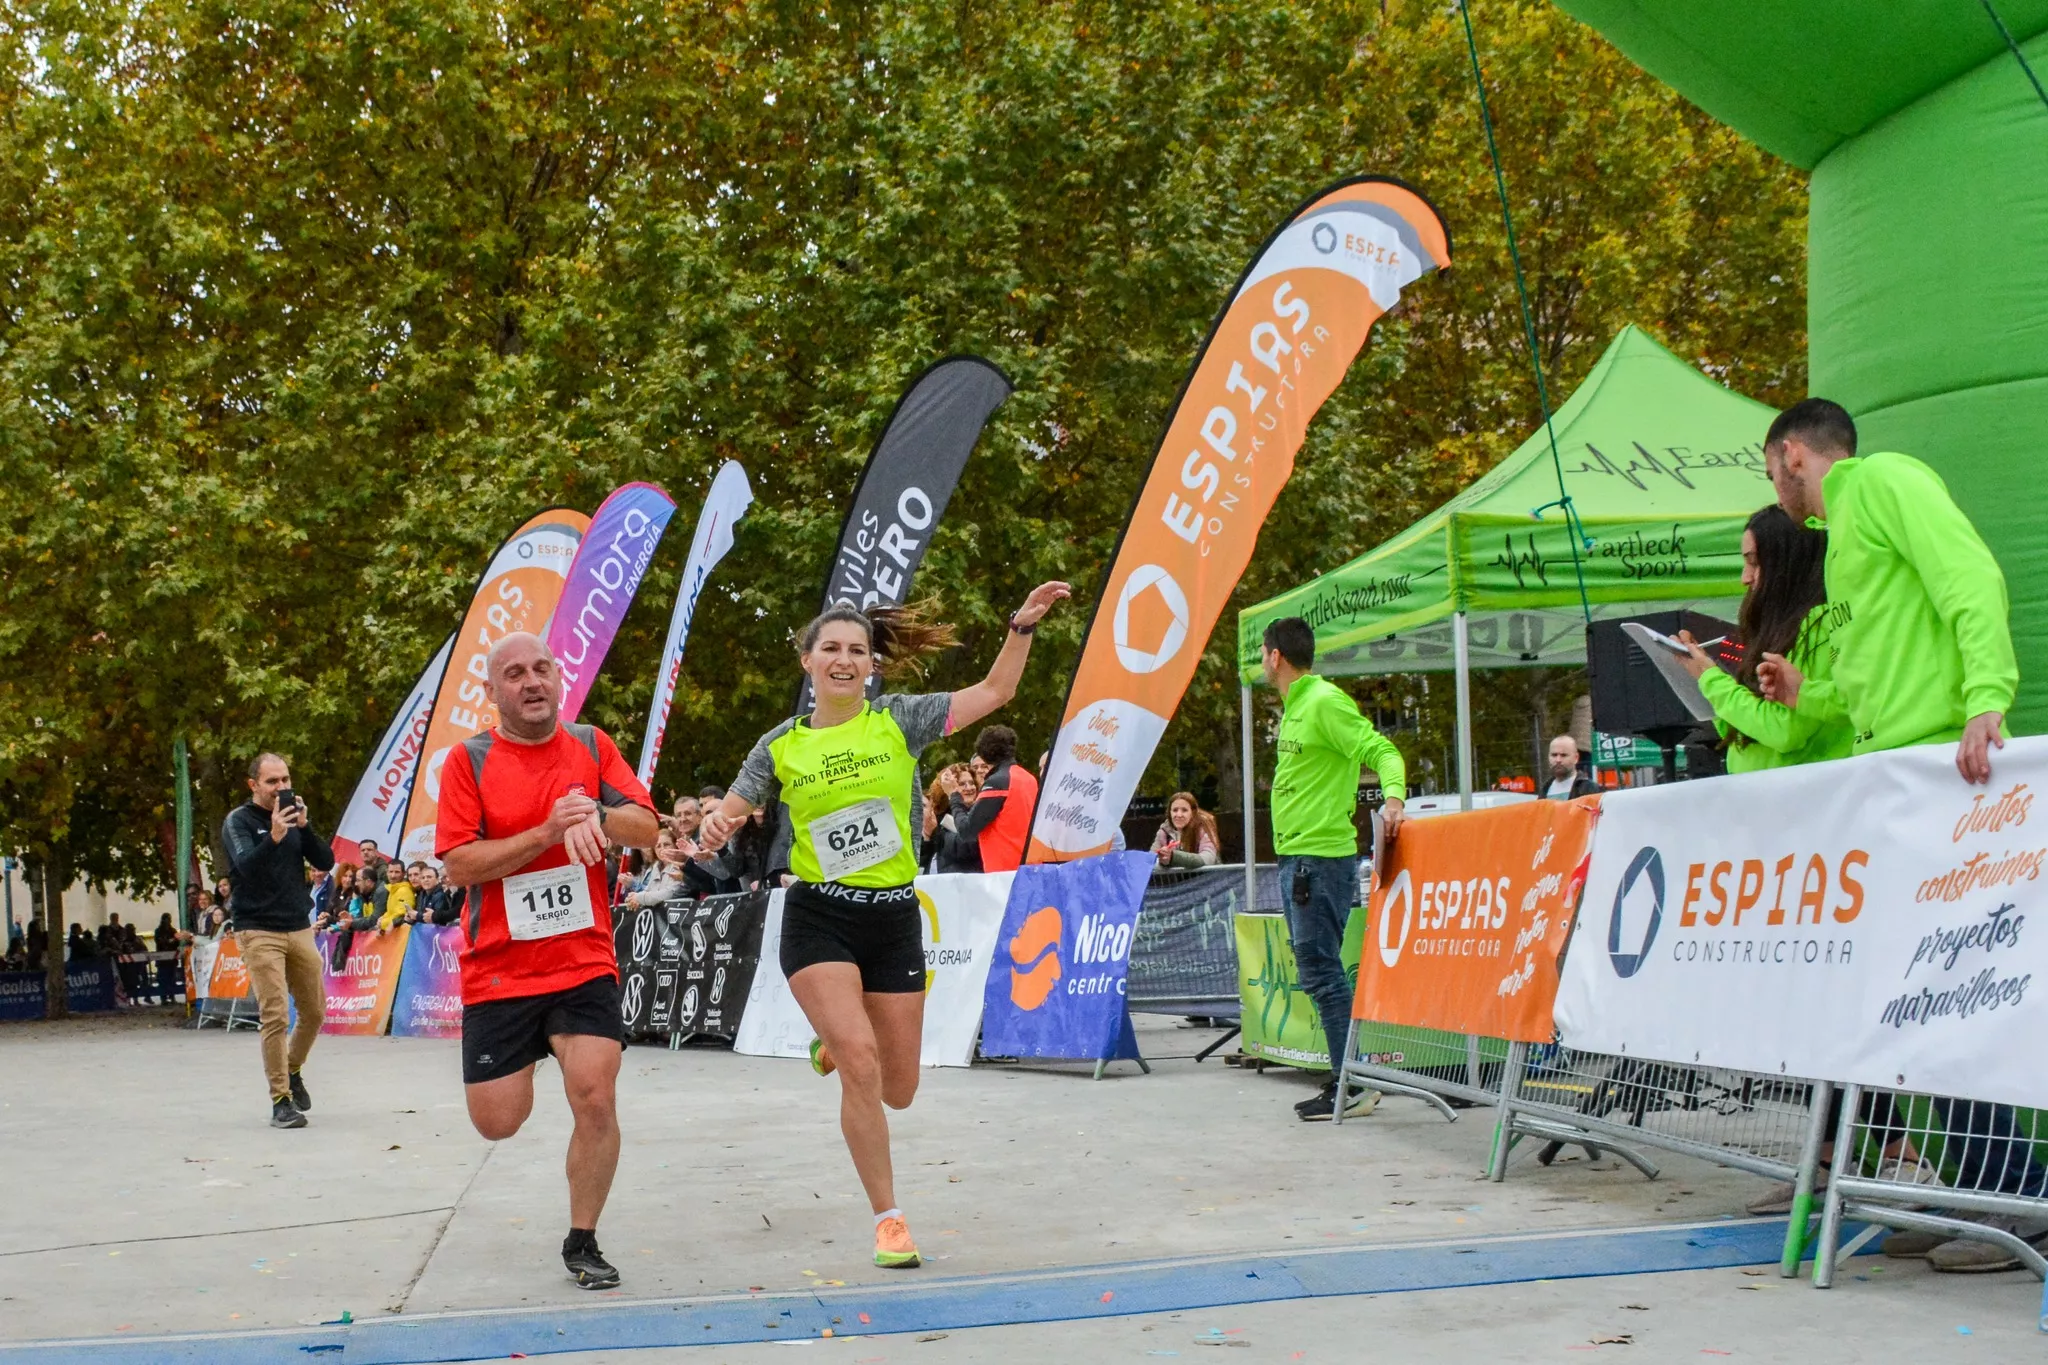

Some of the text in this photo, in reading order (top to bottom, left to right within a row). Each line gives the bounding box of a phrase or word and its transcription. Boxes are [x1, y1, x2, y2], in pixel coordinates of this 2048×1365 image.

[1161, 281, 1310, 545] ESPIAS
[1200, 325, 1330, 558] CONSTRUCTORA
[624, 524, 662, 598] ENERGÍA
[1621, 553, 1688, 580] Sport
[792, 752, 891, 789] AUTO TRANSPORTES
[828, 817, 879, 851] 624
[1952, 783, 2034, 843] Juntos
[842, 840, 880, 859] ROXANA
[522, 884, 573, 913] 118
[810, 882, 914, 905] NIKE PRO
[1679, 849, 1870, 928] ESPIAS
[1915, 848, 2047, 904] construimos
[535, 908, 570, 922] SERGIO
[1418, 876, 1511, 931] ESPIAS
[1413, 938, 1501, 957] CONSTRUCTORA
[1673, 939, 1853, 964] CONSTRUCTORA
[1904, 902, 2025, 980] proyectos
[1880, 966, 2032, 1029] maravillosos
